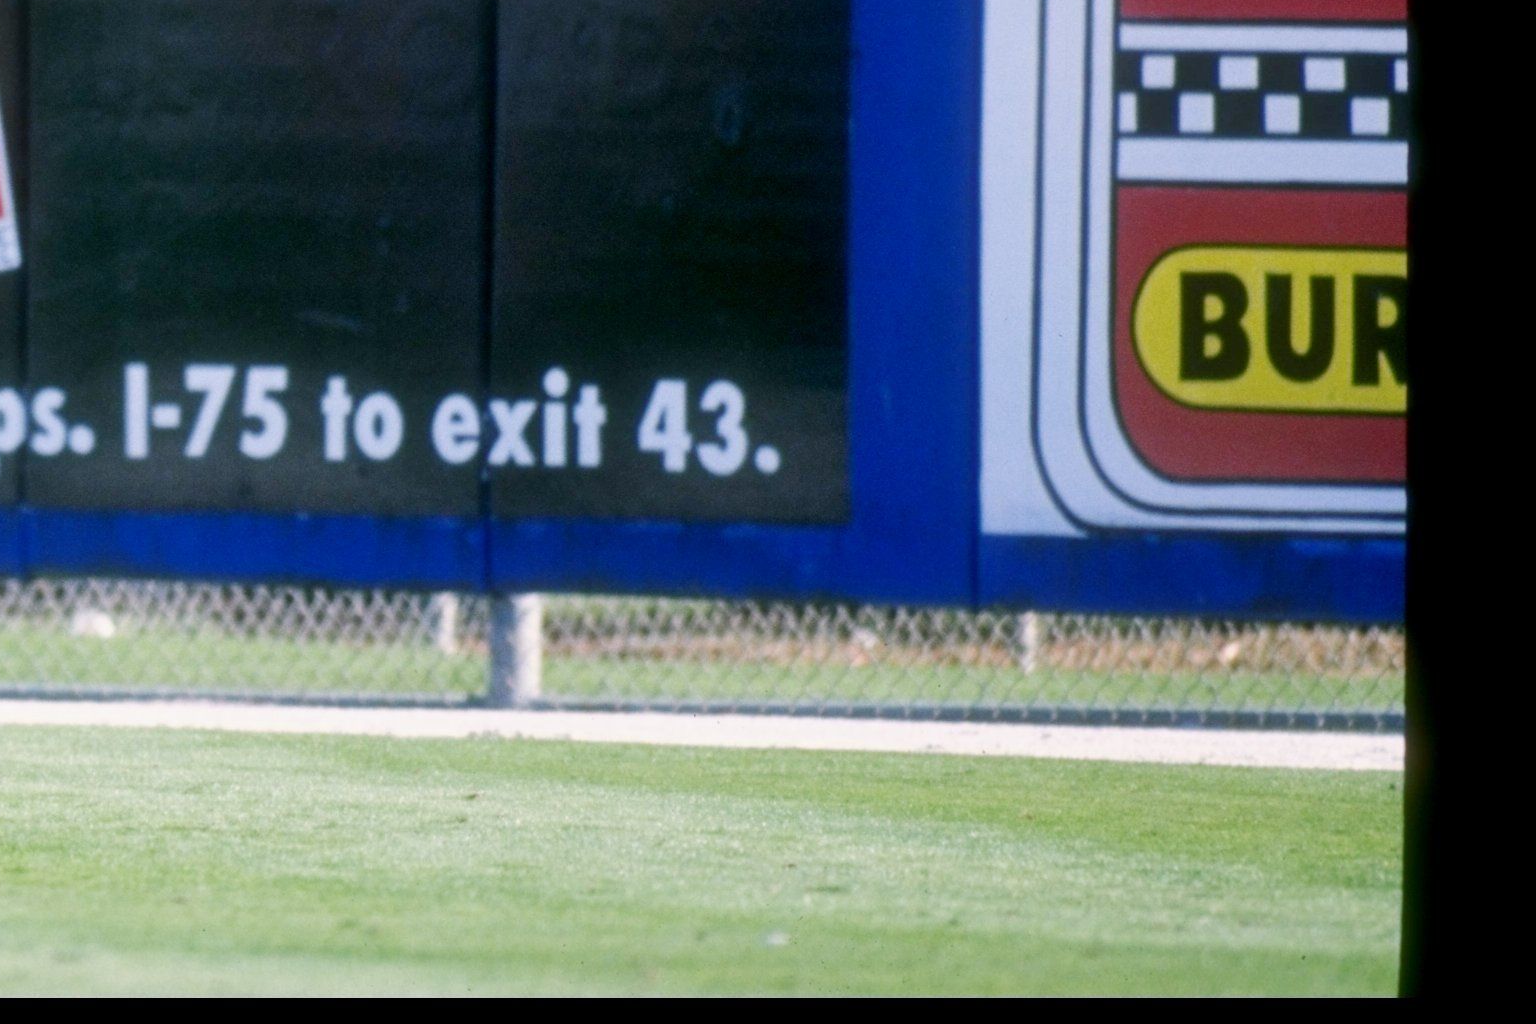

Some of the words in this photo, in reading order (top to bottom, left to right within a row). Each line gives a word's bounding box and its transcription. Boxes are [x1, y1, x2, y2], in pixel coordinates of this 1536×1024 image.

[125, 363, 289, 460] I-75
[321, 377, 404, 462] to
[432, 368, 607, 468] exit
[639, 380, 781, 476] 43.
